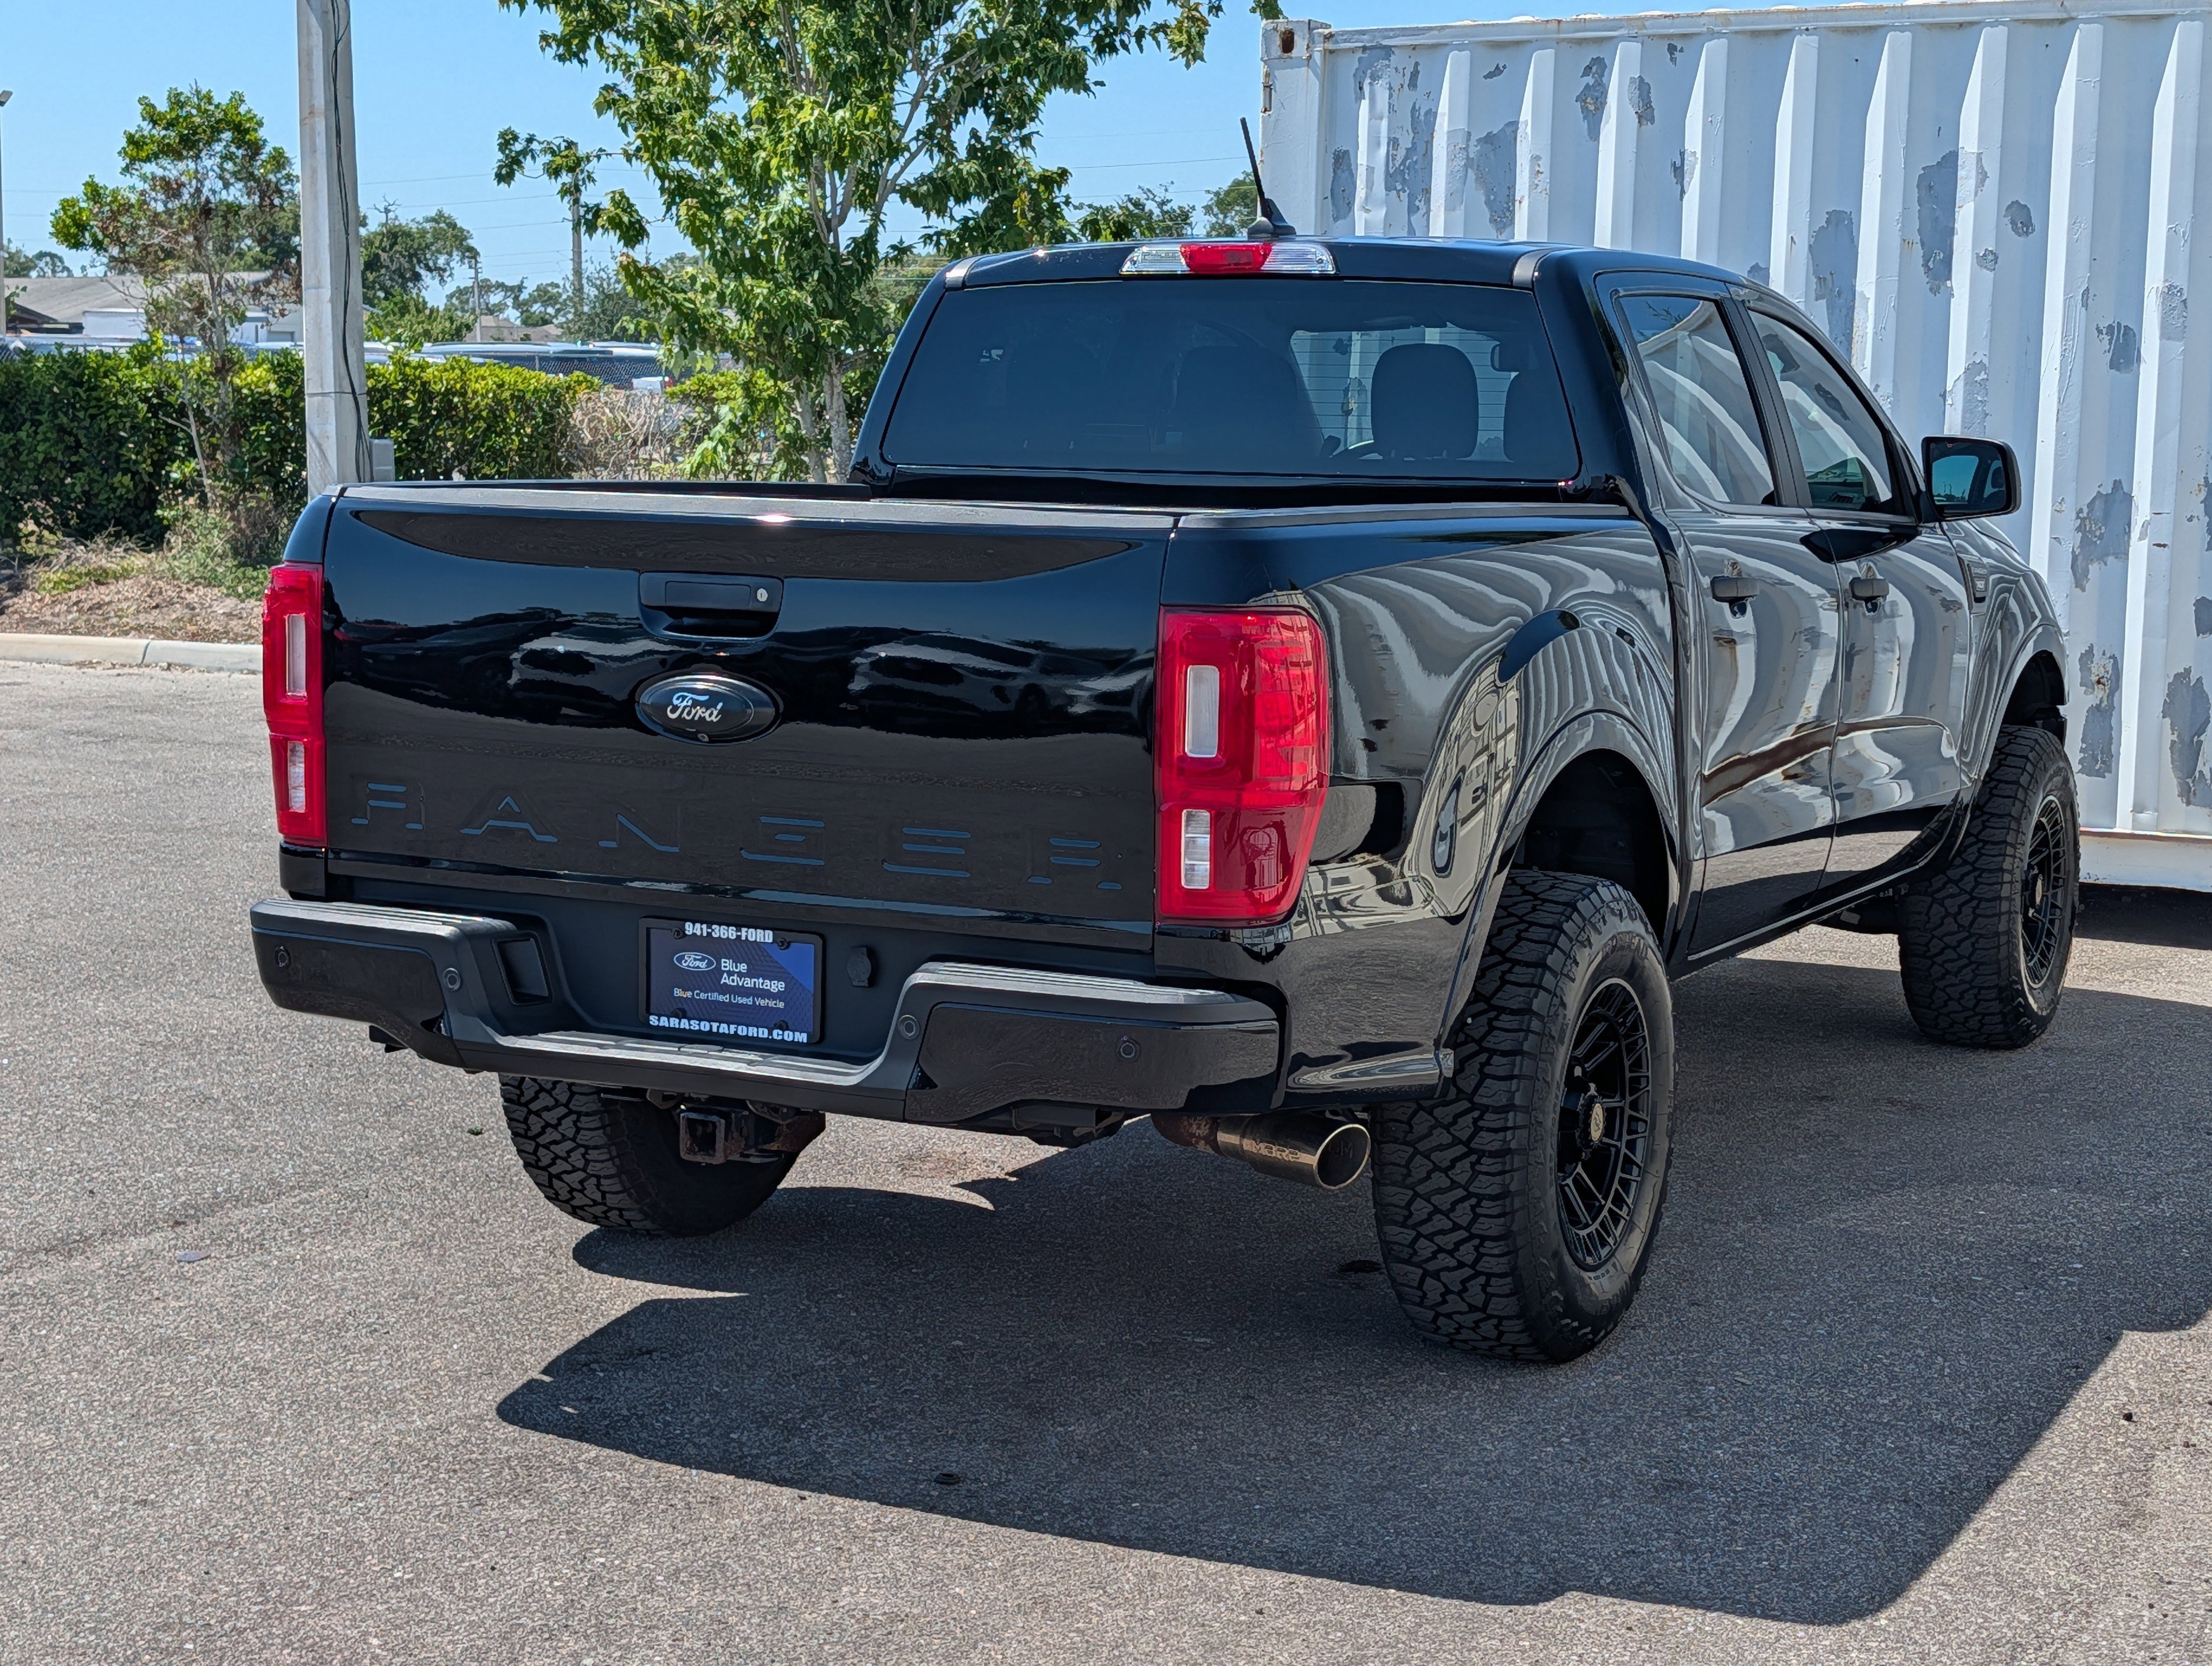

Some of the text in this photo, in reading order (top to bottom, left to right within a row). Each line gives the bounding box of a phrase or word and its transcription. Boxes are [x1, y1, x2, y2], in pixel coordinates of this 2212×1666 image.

[667, 692, 723, 722] Ford
[349, 772, 1122, 889] RANGER
[685, 921, 773, 943] 941-366-FORD
[681, 954, 708, 969] Ford
[721, 959, 747, 973] Blue
[720, 972, 785, 992] Advantage
[674, 988, 785, 1009] Blue Certified Used Vehicle
[648, 1015, 808, 1043] SARASOTAFORD.COM
